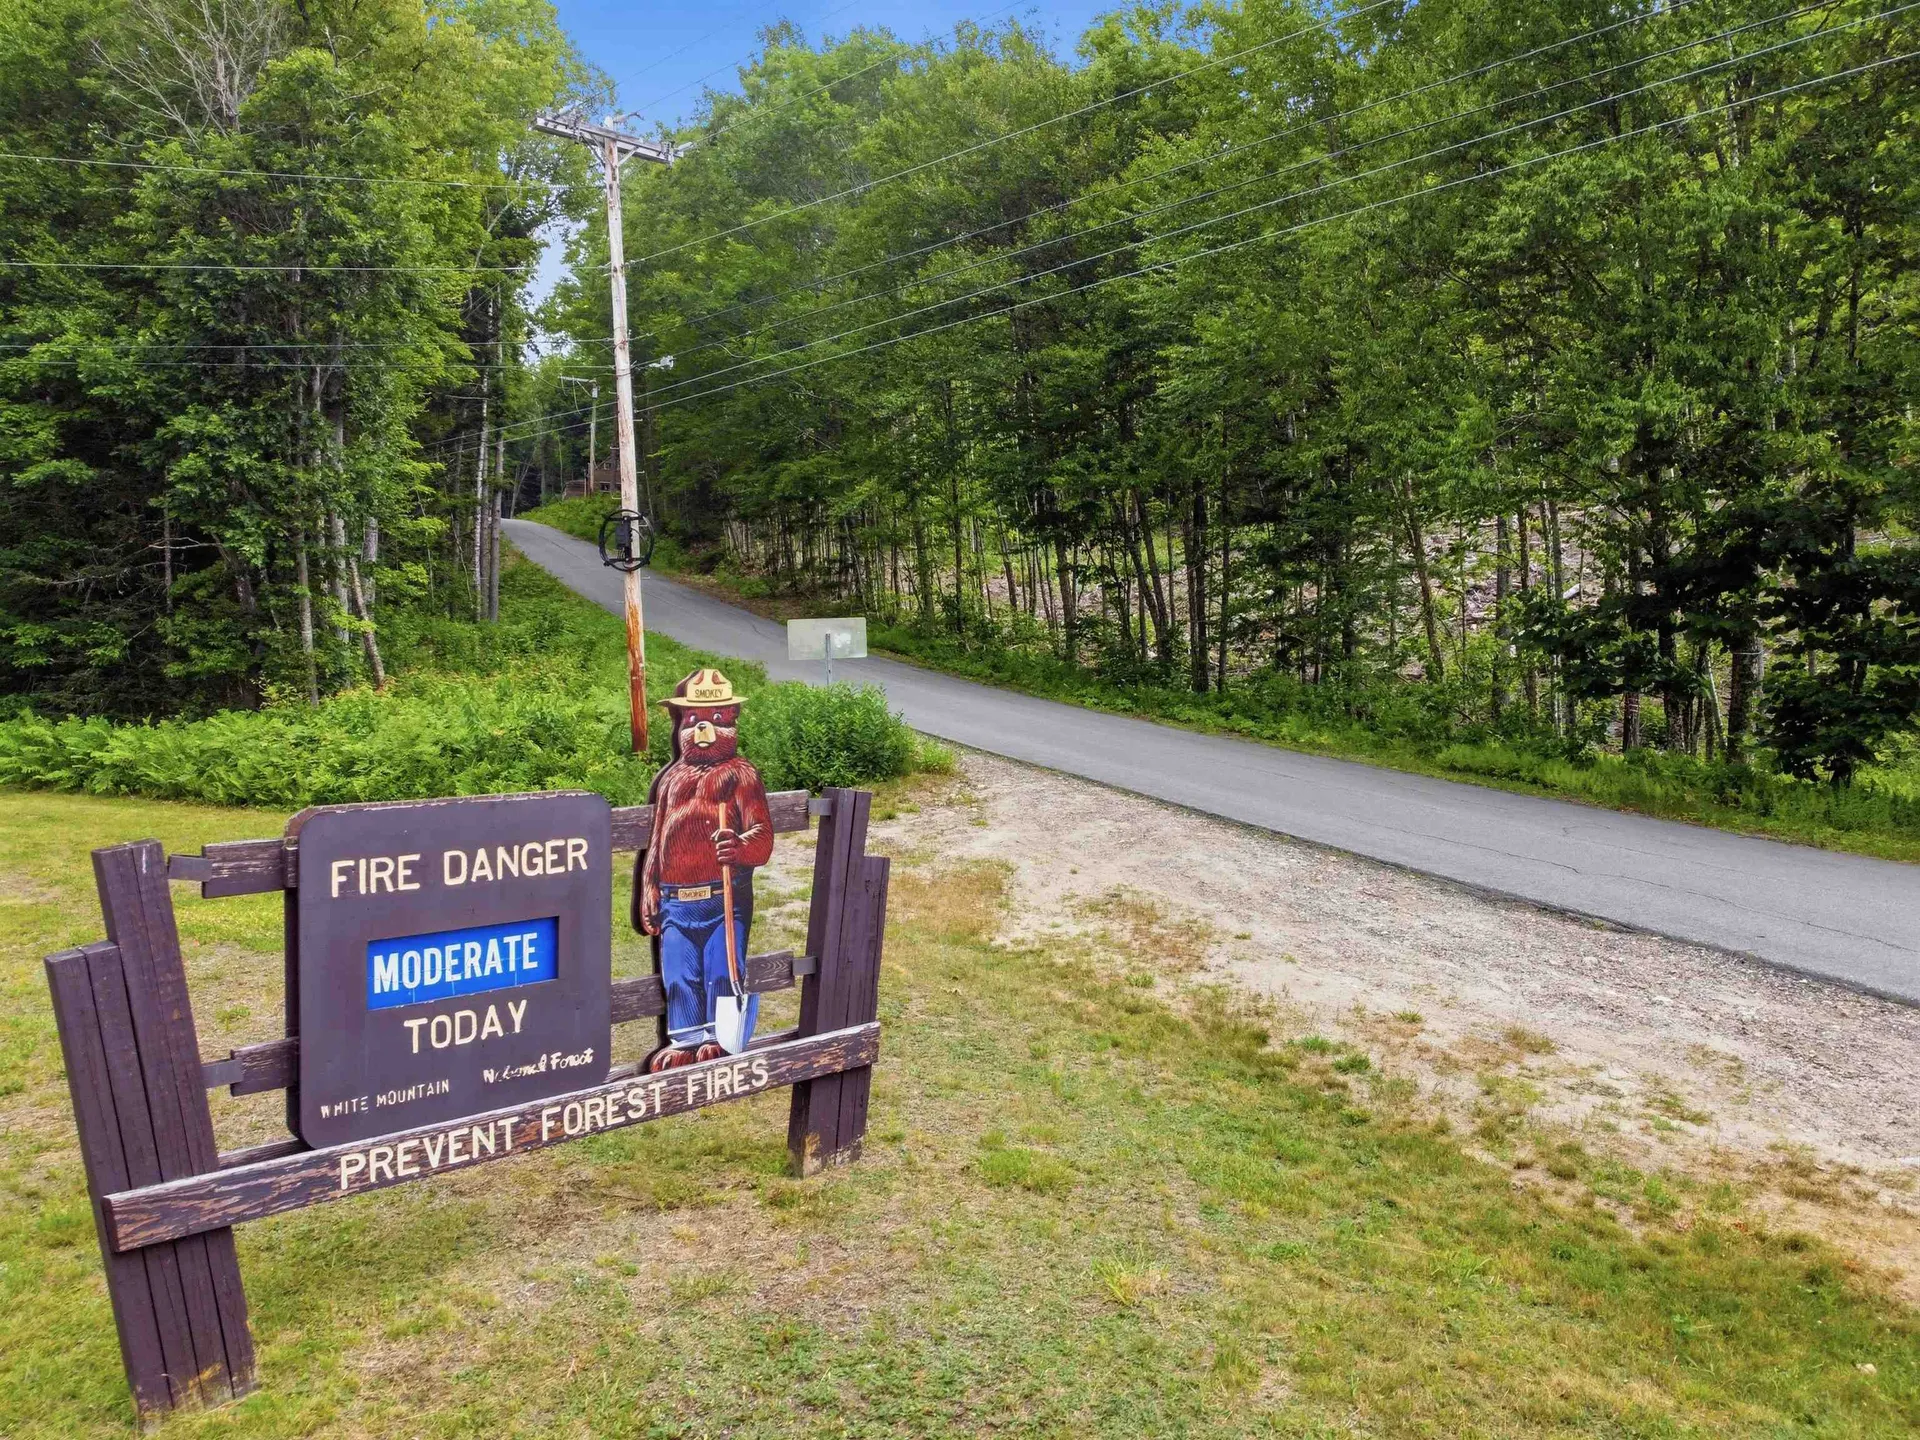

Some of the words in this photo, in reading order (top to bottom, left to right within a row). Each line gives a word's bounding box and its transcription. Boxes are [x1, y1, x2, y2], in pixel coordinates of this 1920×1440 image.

[694, 688, 724, 699] SMOKEY
[330, 853, 421, 898] FIRE
[443, 837, 589, 886] DANGER
[373, 932, 538, 994] MODERATE
[403, 999, 528, 1054] TODAY
[550, 1047, 595, 1071] Forest
[320, 1095, 369, 1119] WHITE
[376, 1078, 450, 1108] MOUNTAIN
[339, 1116, 520, 1191] PREVENT
[541, 1080, 670, 1142] FOREST
[687, 1058, 769, 1105] FIRES
